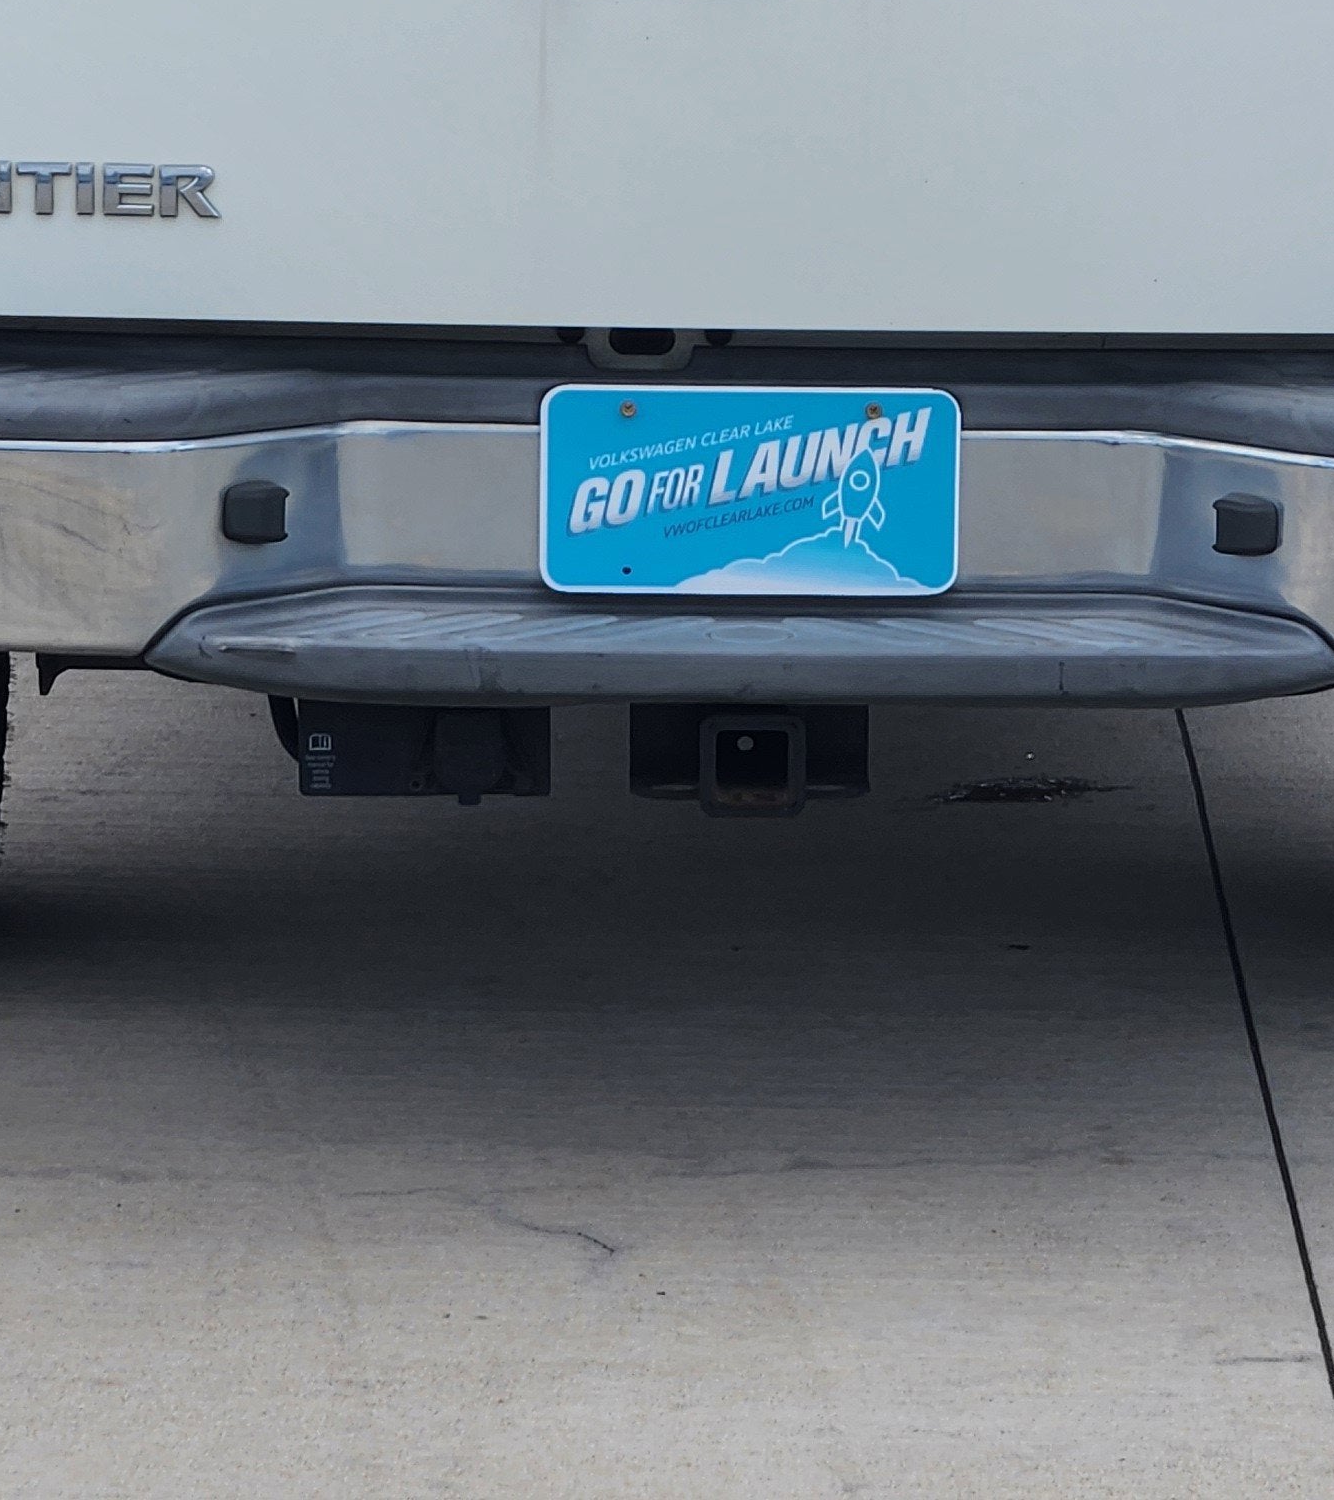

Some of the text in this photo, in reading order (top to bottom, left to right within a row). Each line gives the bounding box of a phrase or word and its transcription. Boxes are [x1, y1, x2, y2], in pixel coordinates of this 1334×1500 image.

[569, 407, 933, 535] GO FOR LAUNCH
[589, 414, 795, 471] VOLKSWAGEN CLEAR LAKE
[662, 495, 815, 538] VWOFCLEARLAKE.COM
